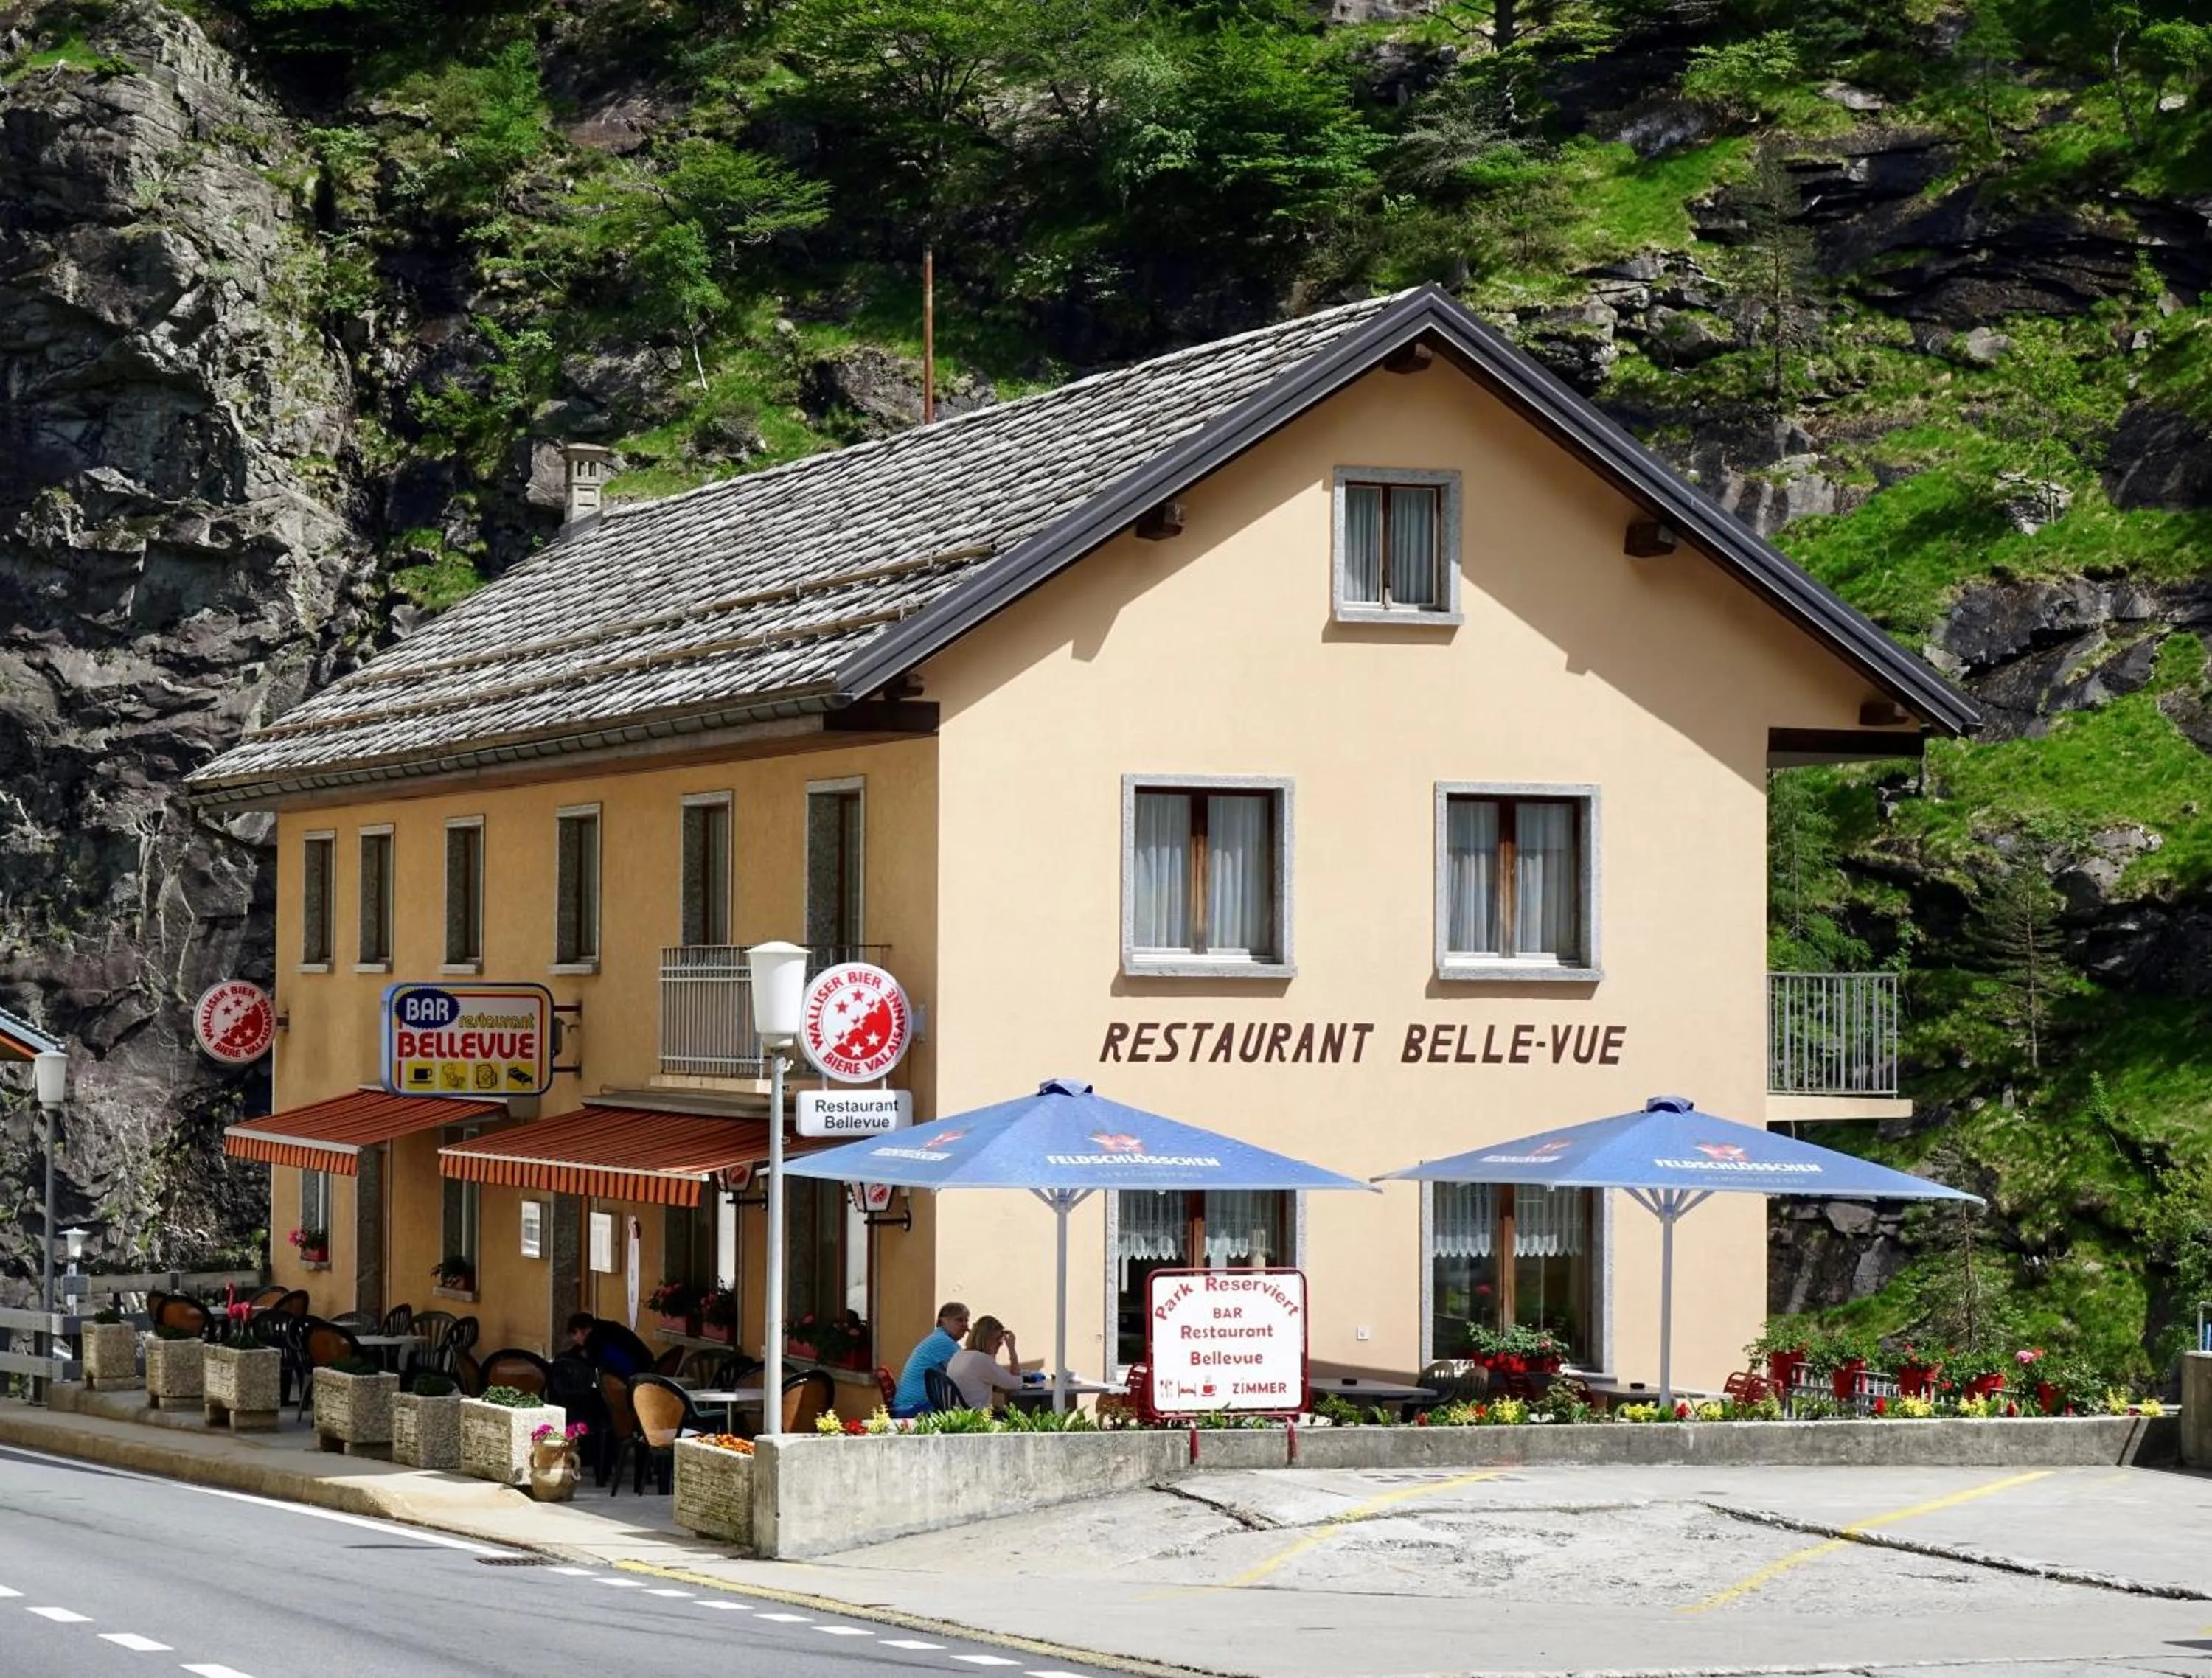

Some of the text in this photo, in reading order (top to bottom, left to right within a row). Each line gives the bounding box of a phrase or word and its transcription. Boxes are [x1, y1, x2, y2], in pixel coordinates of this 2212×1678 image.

[202, 986, 256, 1042] WALLISER BIER
[406, 998, 449, 1021] BAR
[808, 972, 882, 1050] WALLISER BIER
[459, 1012, 535, 1029] restaurant
[822, 987, 906, 1075] BIERE VALAISANNE
[213, 1042, 241, 1058] BIERE
[397, 1031, 535, 1059] BELLEVUE
[1099, 1022, 1627, 1065] RESTAURANT BELLE-VUE
[815, 1099, 899, 1113] Restaurant
[824, 1115, 891, 1129] Bellevue
[1155, 1276, 1299, 1320] Park Reserviert
[1213, 1307, 1242, 1319] BAR
[1180, 1324, 1274, 1340] Restaurant
[1190, 1351, 1263, 1365] Bellevue
[1232, 1382, 1287, 1395] ZIMMER
